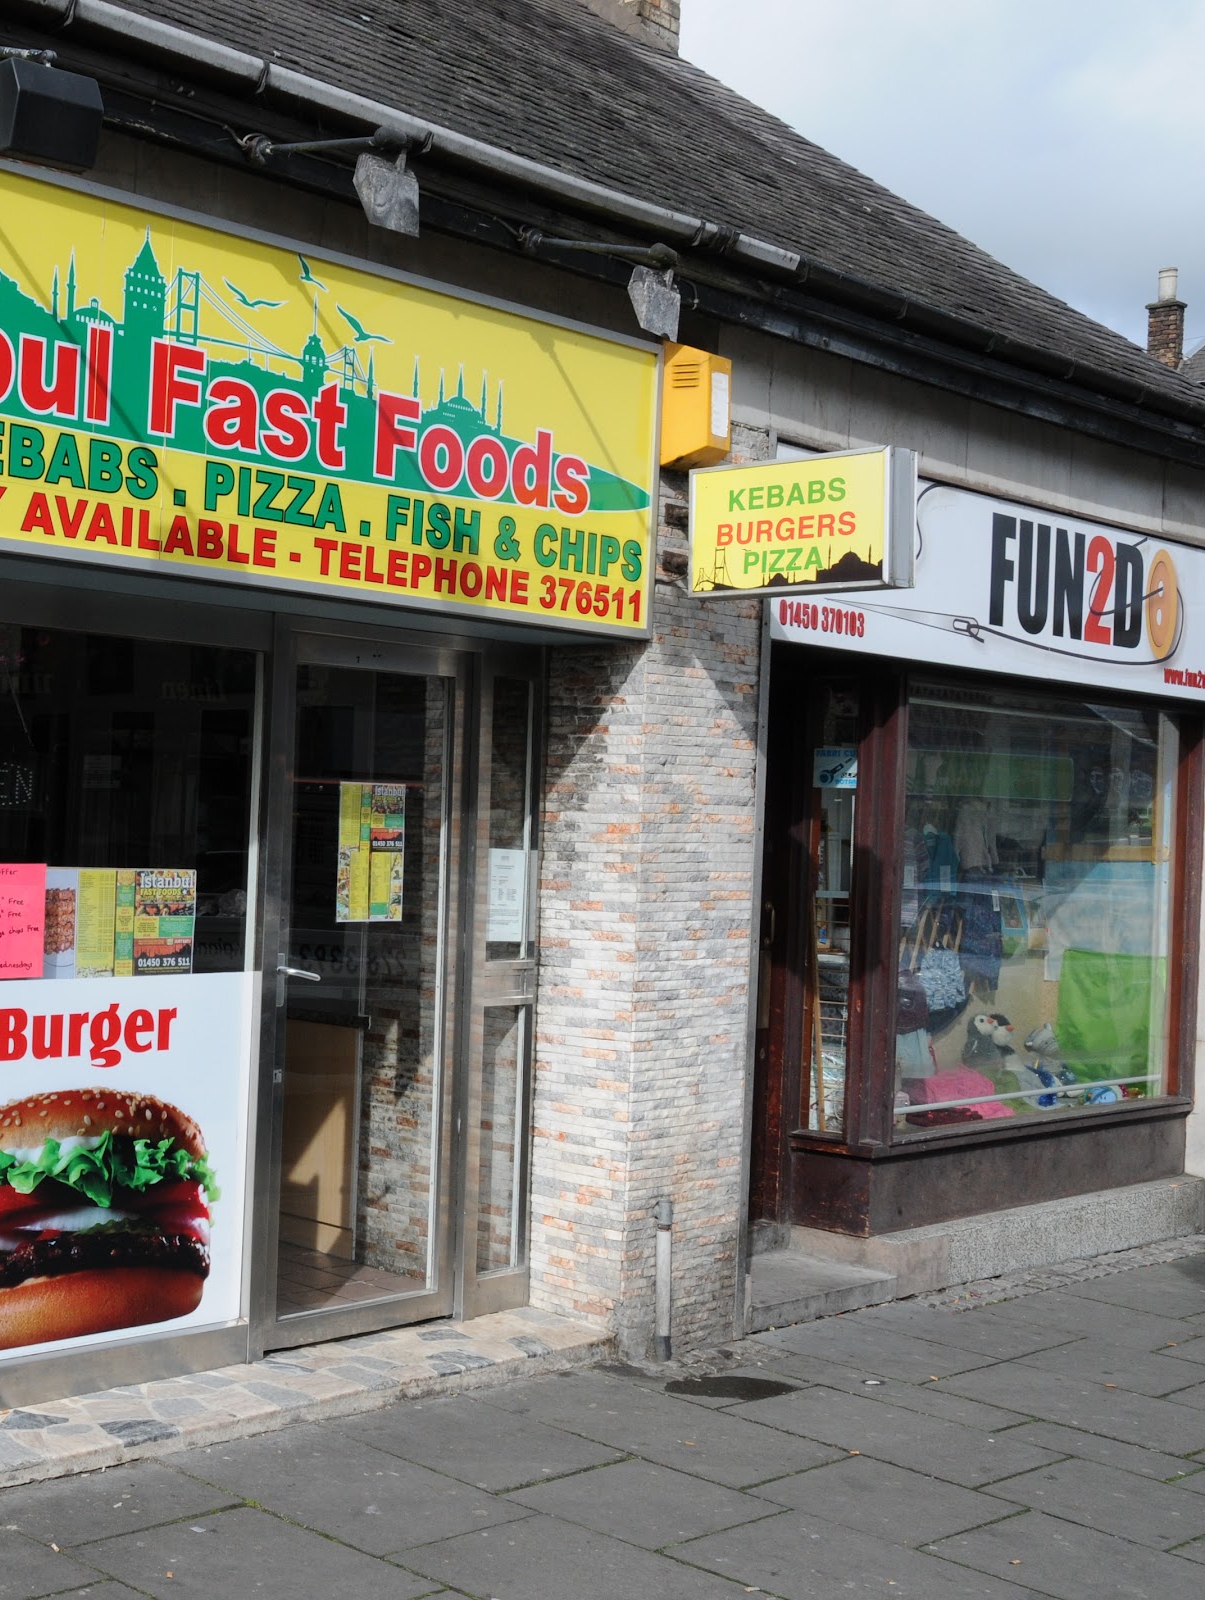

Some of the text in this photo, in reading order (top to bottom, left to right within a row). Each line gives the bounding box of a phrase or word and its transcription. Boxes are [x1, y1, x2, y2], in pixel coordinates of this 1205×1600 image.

[148, 338, 347, 470] Fast
[373, 392, 591, 515] Foods
[728, 476, 847, 513] KEBABS
[204, 460, 347, 533] PIZZA
[385, 494, 481, 555] FISH
[494, 515, 522, 562] &
[534, 523, 643, 581] CHIPS
[716, 510, 857, 547] BURGERS
[20, 491, 277, 568] AVAILABLE
[313, 537, 530, 606] TELEPHONE
[538, 574, 643, 623] 376511
[742, 545, 825, 575] PIZZA
[779, 598, 865, 638] 01450 370103
[1163, 667, 1205, 689] www.fun2
[140, 872, 194, 889] Istanbul
[140, 888, 157, 896] FAST
[158, 888, 182, 896] FOODS
[8, 898, 24, 906] Free
[26, 924, 40, 933] Free
[137, 958, 161, 968] 01450
[162, 957, 176, 967] 376
[177, 956, 190, 966] 511
